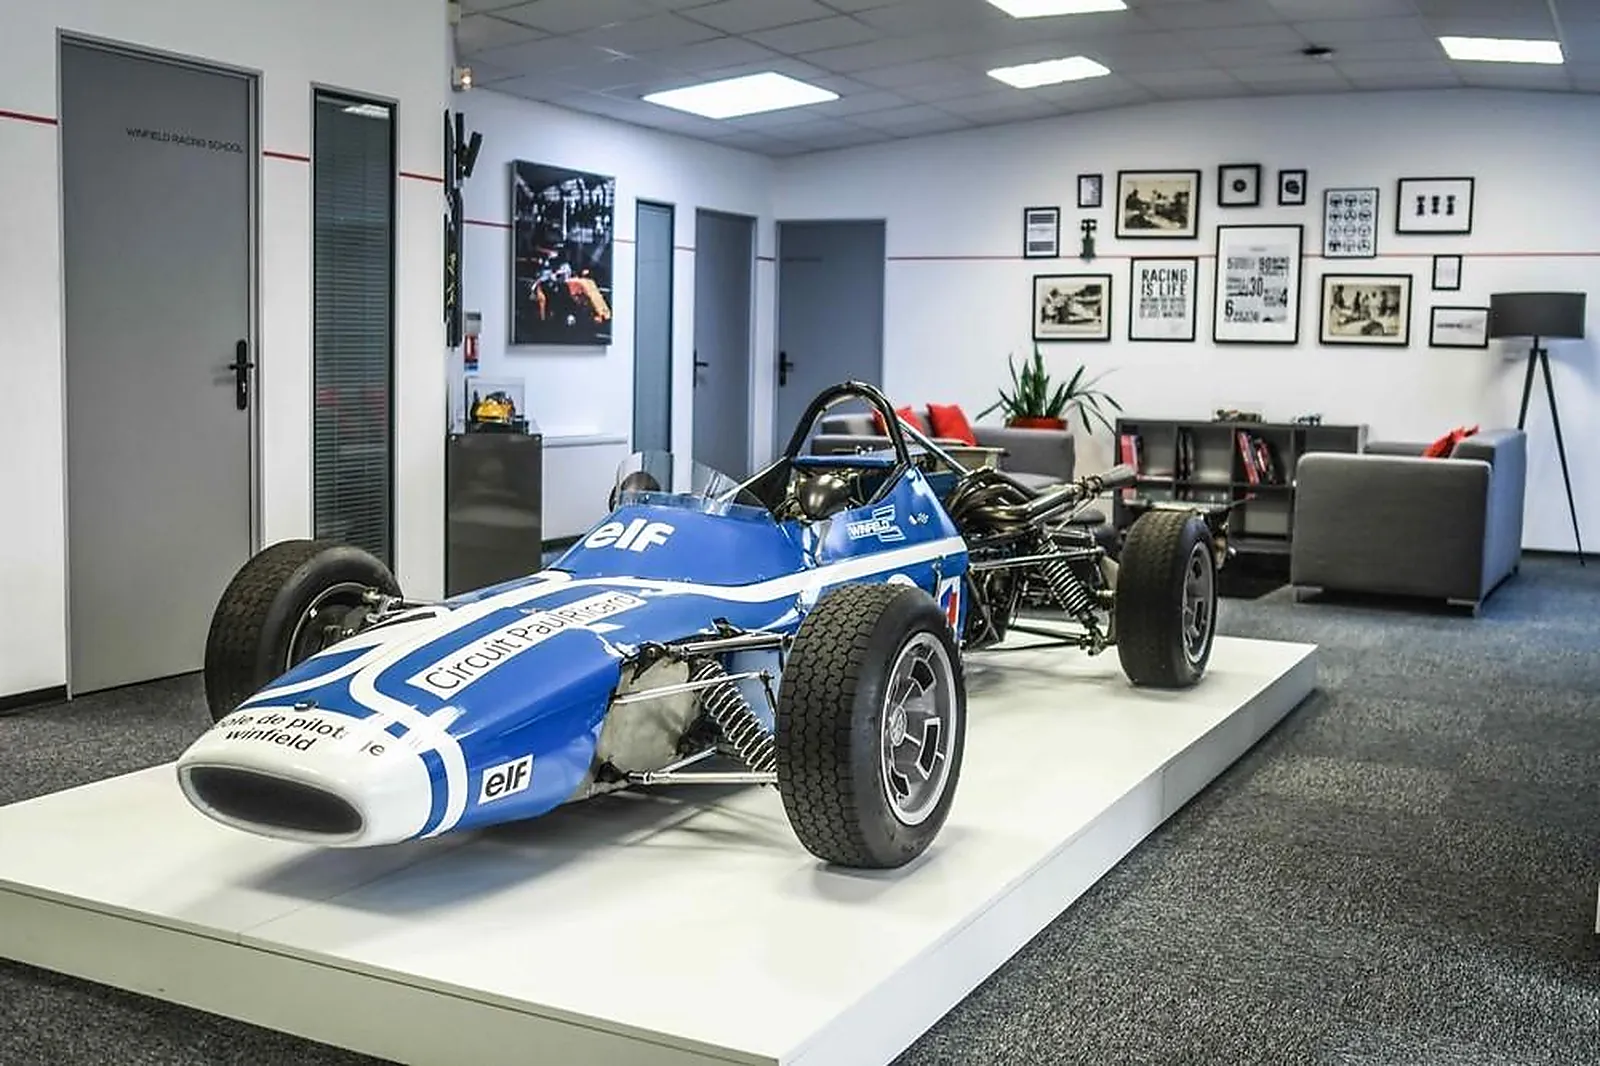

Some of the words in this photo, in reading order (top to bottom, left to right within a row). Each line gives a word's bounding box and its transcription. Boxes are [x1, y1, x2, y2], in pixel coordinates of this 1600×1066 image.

[1142, 268, 1188, 282] RACING
[1141, 282, 1153, 296] IS
[1159, 282, 1187, 296] LIFE
[1225, 300, 1235, 318] 6
[584, 518, 675, 552] elf
[425, 636, 523, 690] Circuit
[509, 612, 575, 643] Paul
[557, 596, 636, 624] Ricard
[256, 713, 286, 726] de
[225, 727, 317, 751] winfield
[485, 760, 528, 797] elf
